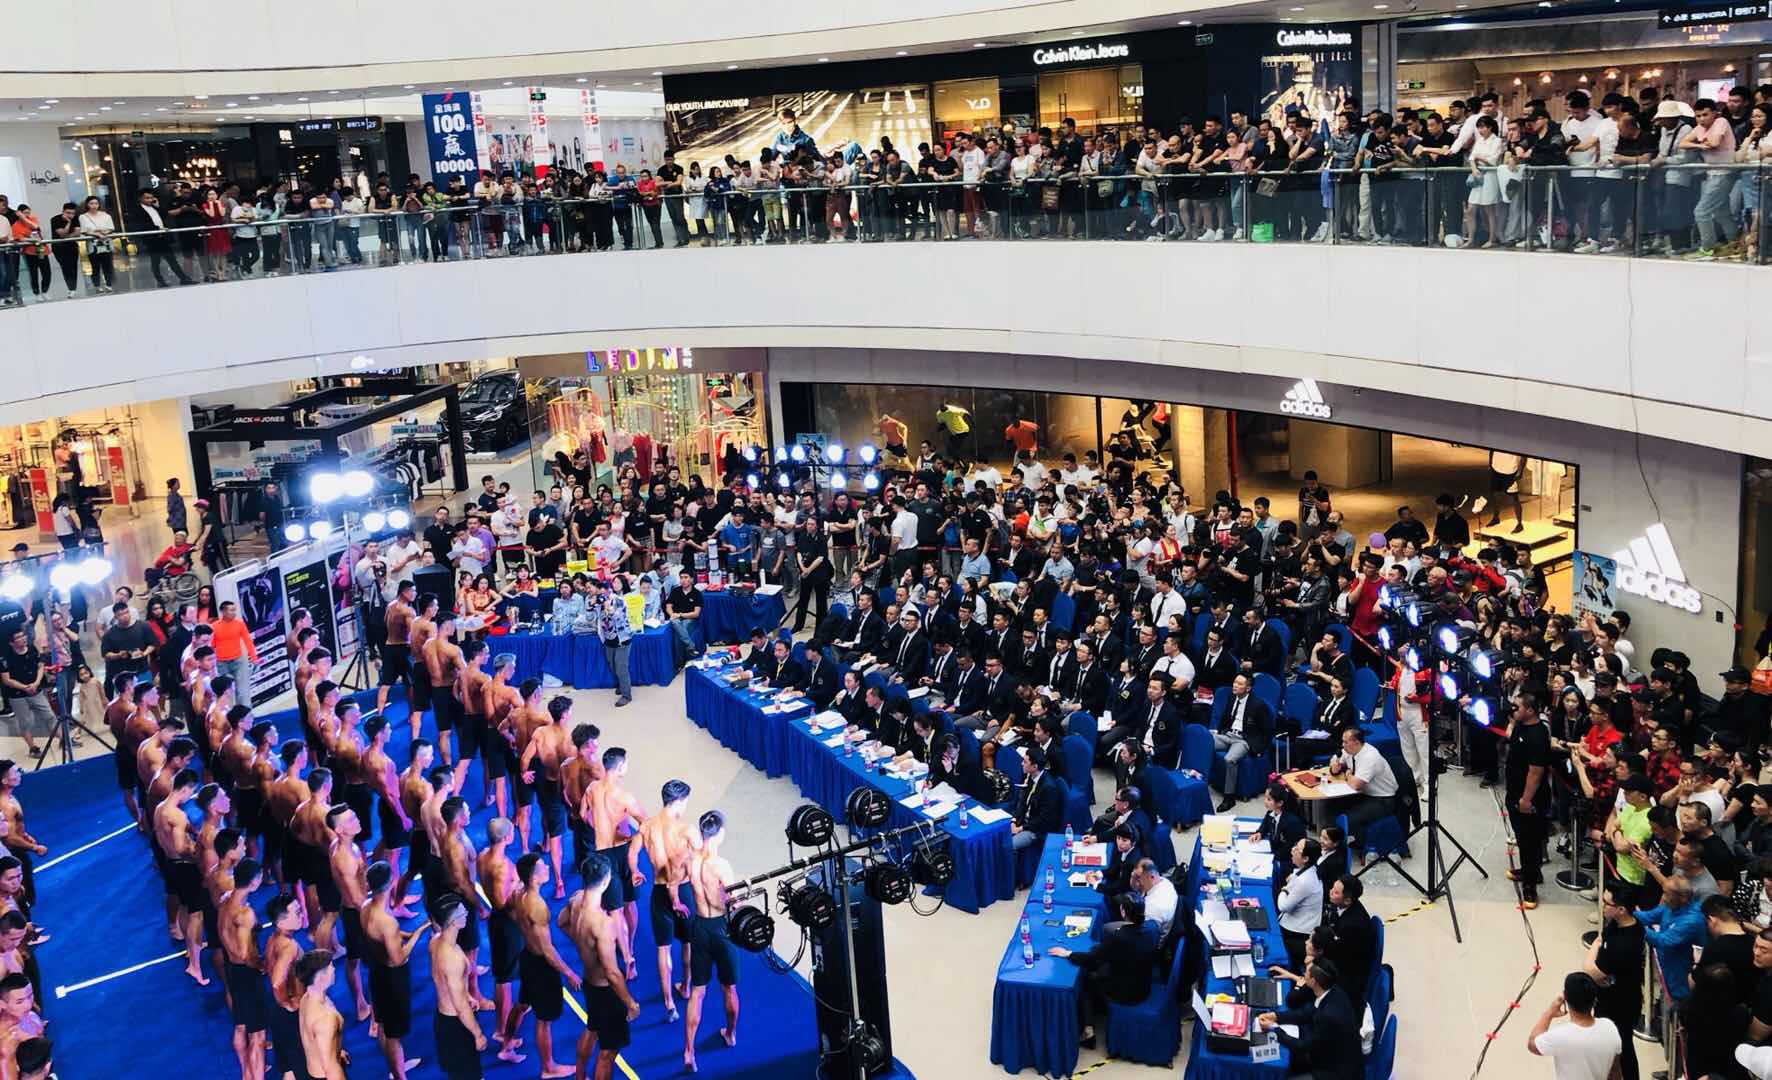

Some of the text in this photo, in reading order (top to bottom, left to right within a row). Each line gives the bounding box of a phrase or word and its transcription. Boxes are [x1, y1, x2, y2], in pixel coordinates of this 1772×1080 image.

[1033, 43, 1129, 64] Calvin Klein Jeans
[1280, 398, 1331, 418] adidas
[1616, 563, 1702, 614] didas
